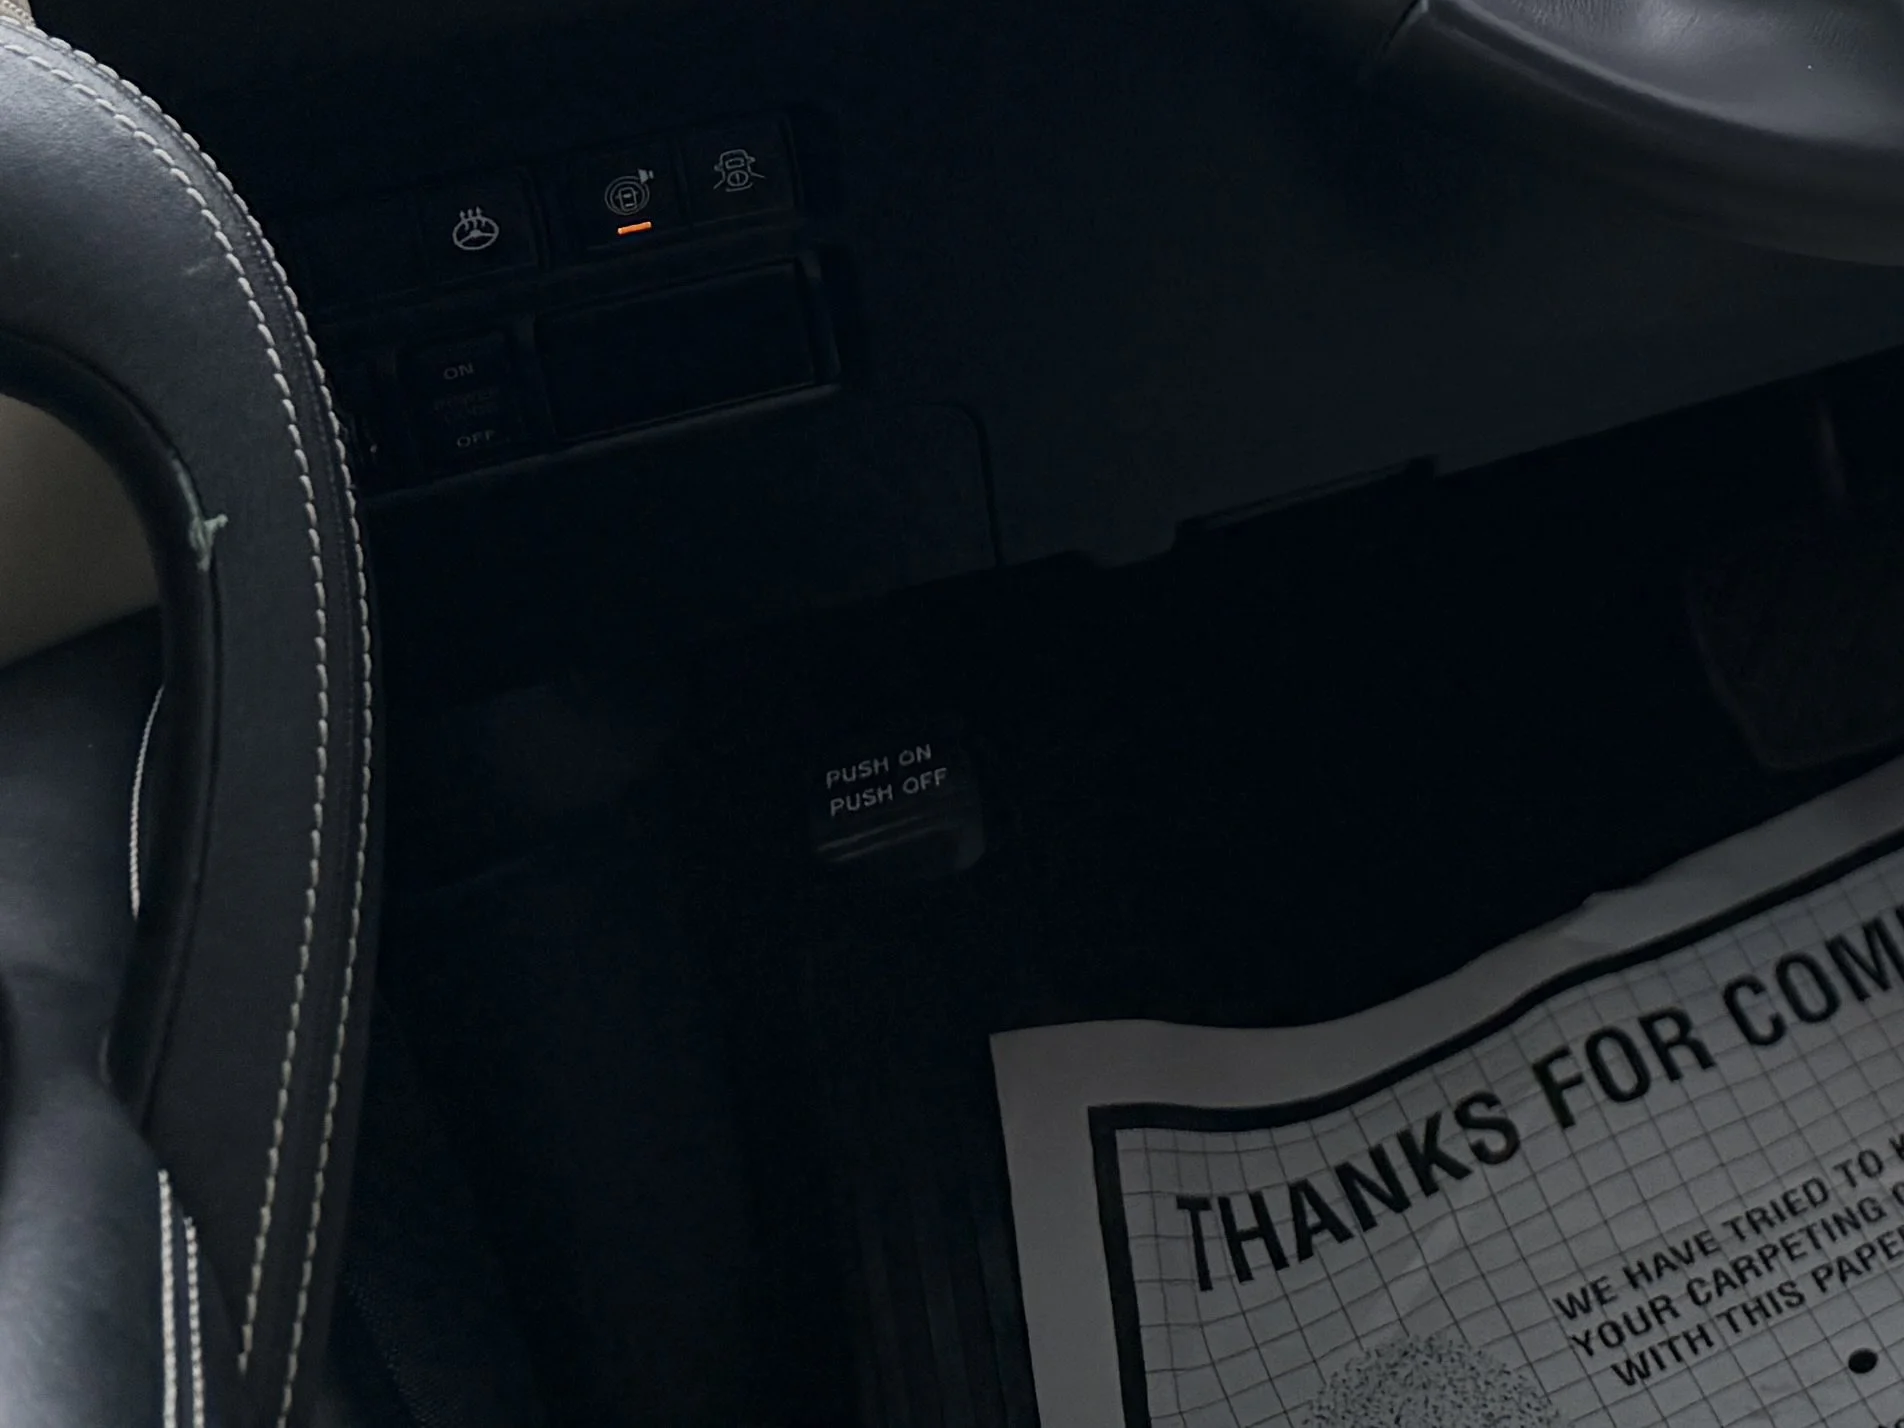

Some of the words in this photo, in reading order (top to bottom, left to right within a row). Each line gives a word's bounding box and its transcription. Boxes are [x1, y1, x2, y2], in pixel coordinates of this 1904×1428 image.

[442, 361, 476, 381] ON
[456, 429, 497, 449] OFF
[826, 755, 890, 790] PUSH
[898, 743, 932, 767] ON
[830, 783, 894, 817] PUSH
[902, 767, 948, 795] OFF
[1174, 1091, 1523, 1292] THANKS
[1529, 1005, 1717, 1132] FOR
[1551, 1275, 1620, 1322] WE
[1620, 1228, 1722, 1291] HAVE
[1720, 1177, 1831, 1244] TRIED
[1831, 1148, 1884, 1189] TO
[1570, 1293, 1682, 1358] YOUR
[1685, 1195, 1888, 1308] CARPETING
[1610, 1323, 1716, 1388] WITH
[1715, 1280, 1807, 1337] THIS
